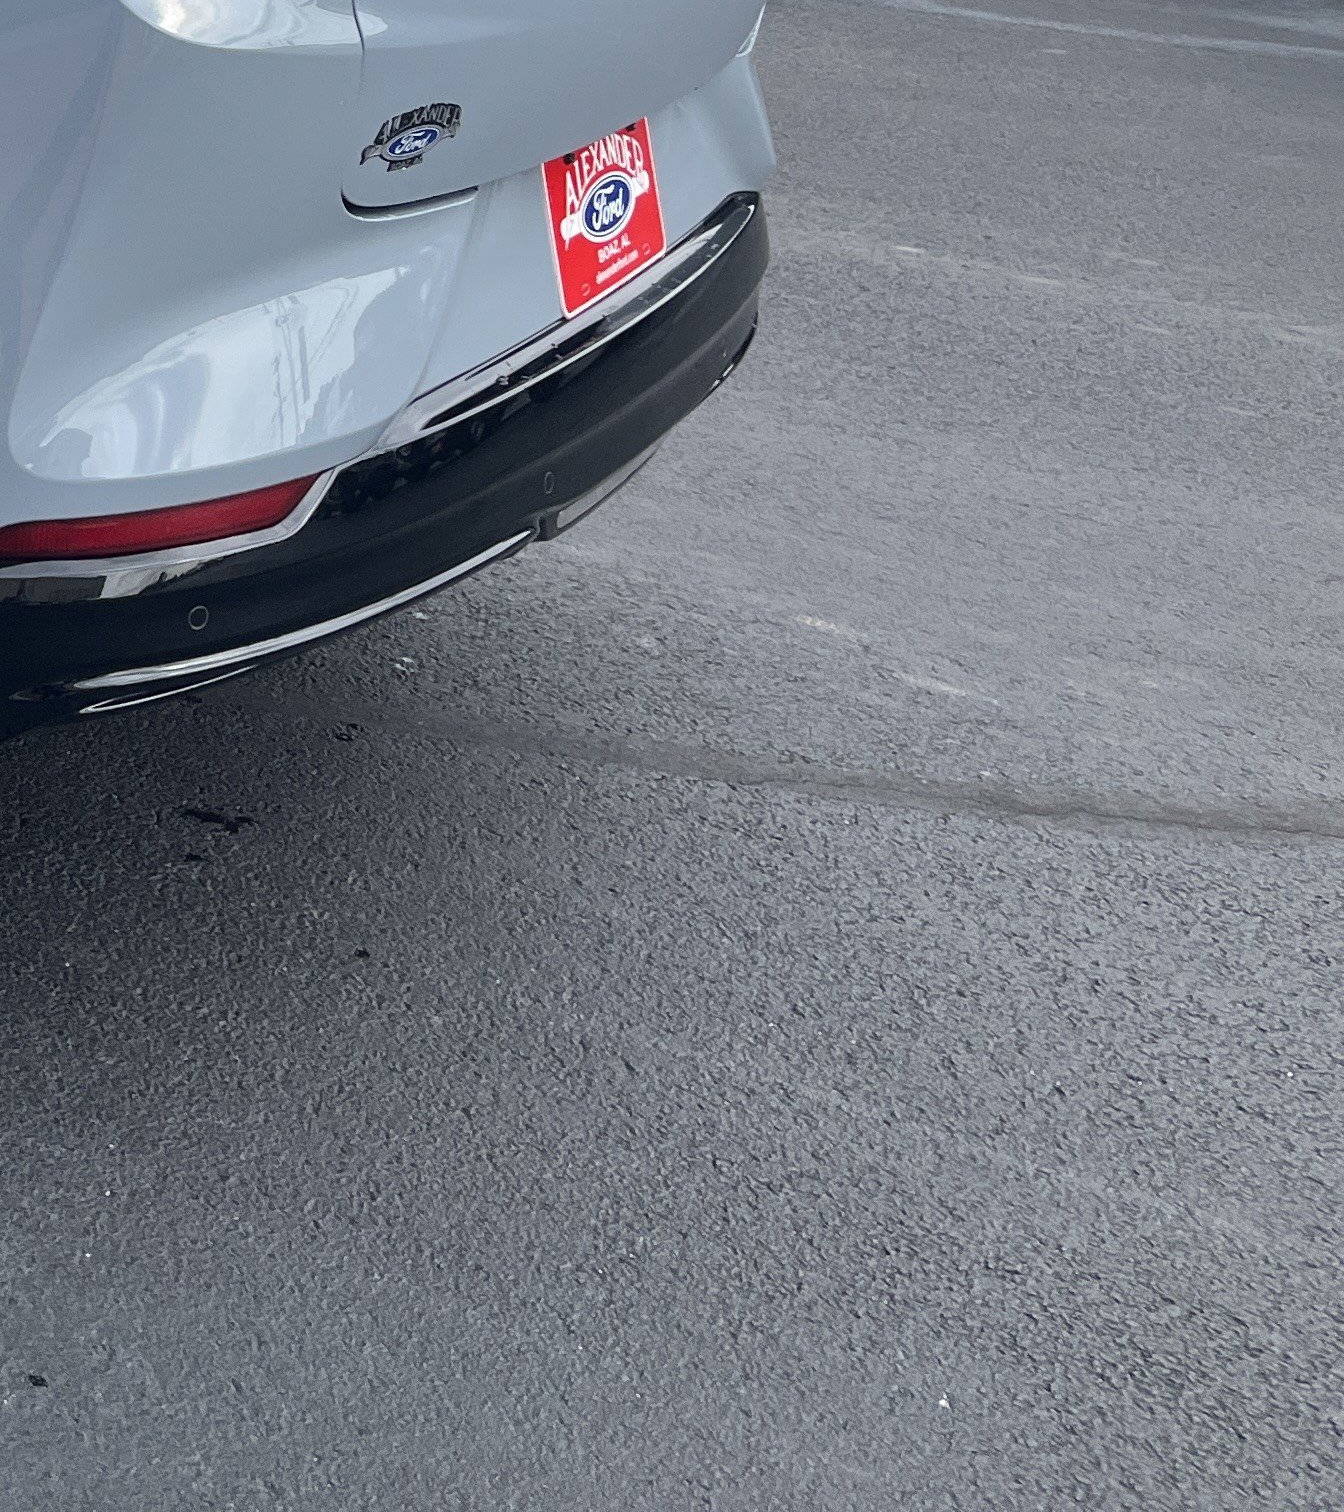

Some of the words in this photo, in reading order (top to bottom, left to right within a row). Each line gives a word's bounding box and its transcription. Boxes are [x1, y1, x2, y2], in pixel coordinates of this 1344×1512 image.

[394, 130, 433, 154] Ford
[564, 134, 647, 233] ALEXANDER
[592, 184, 625, 231] Ford
